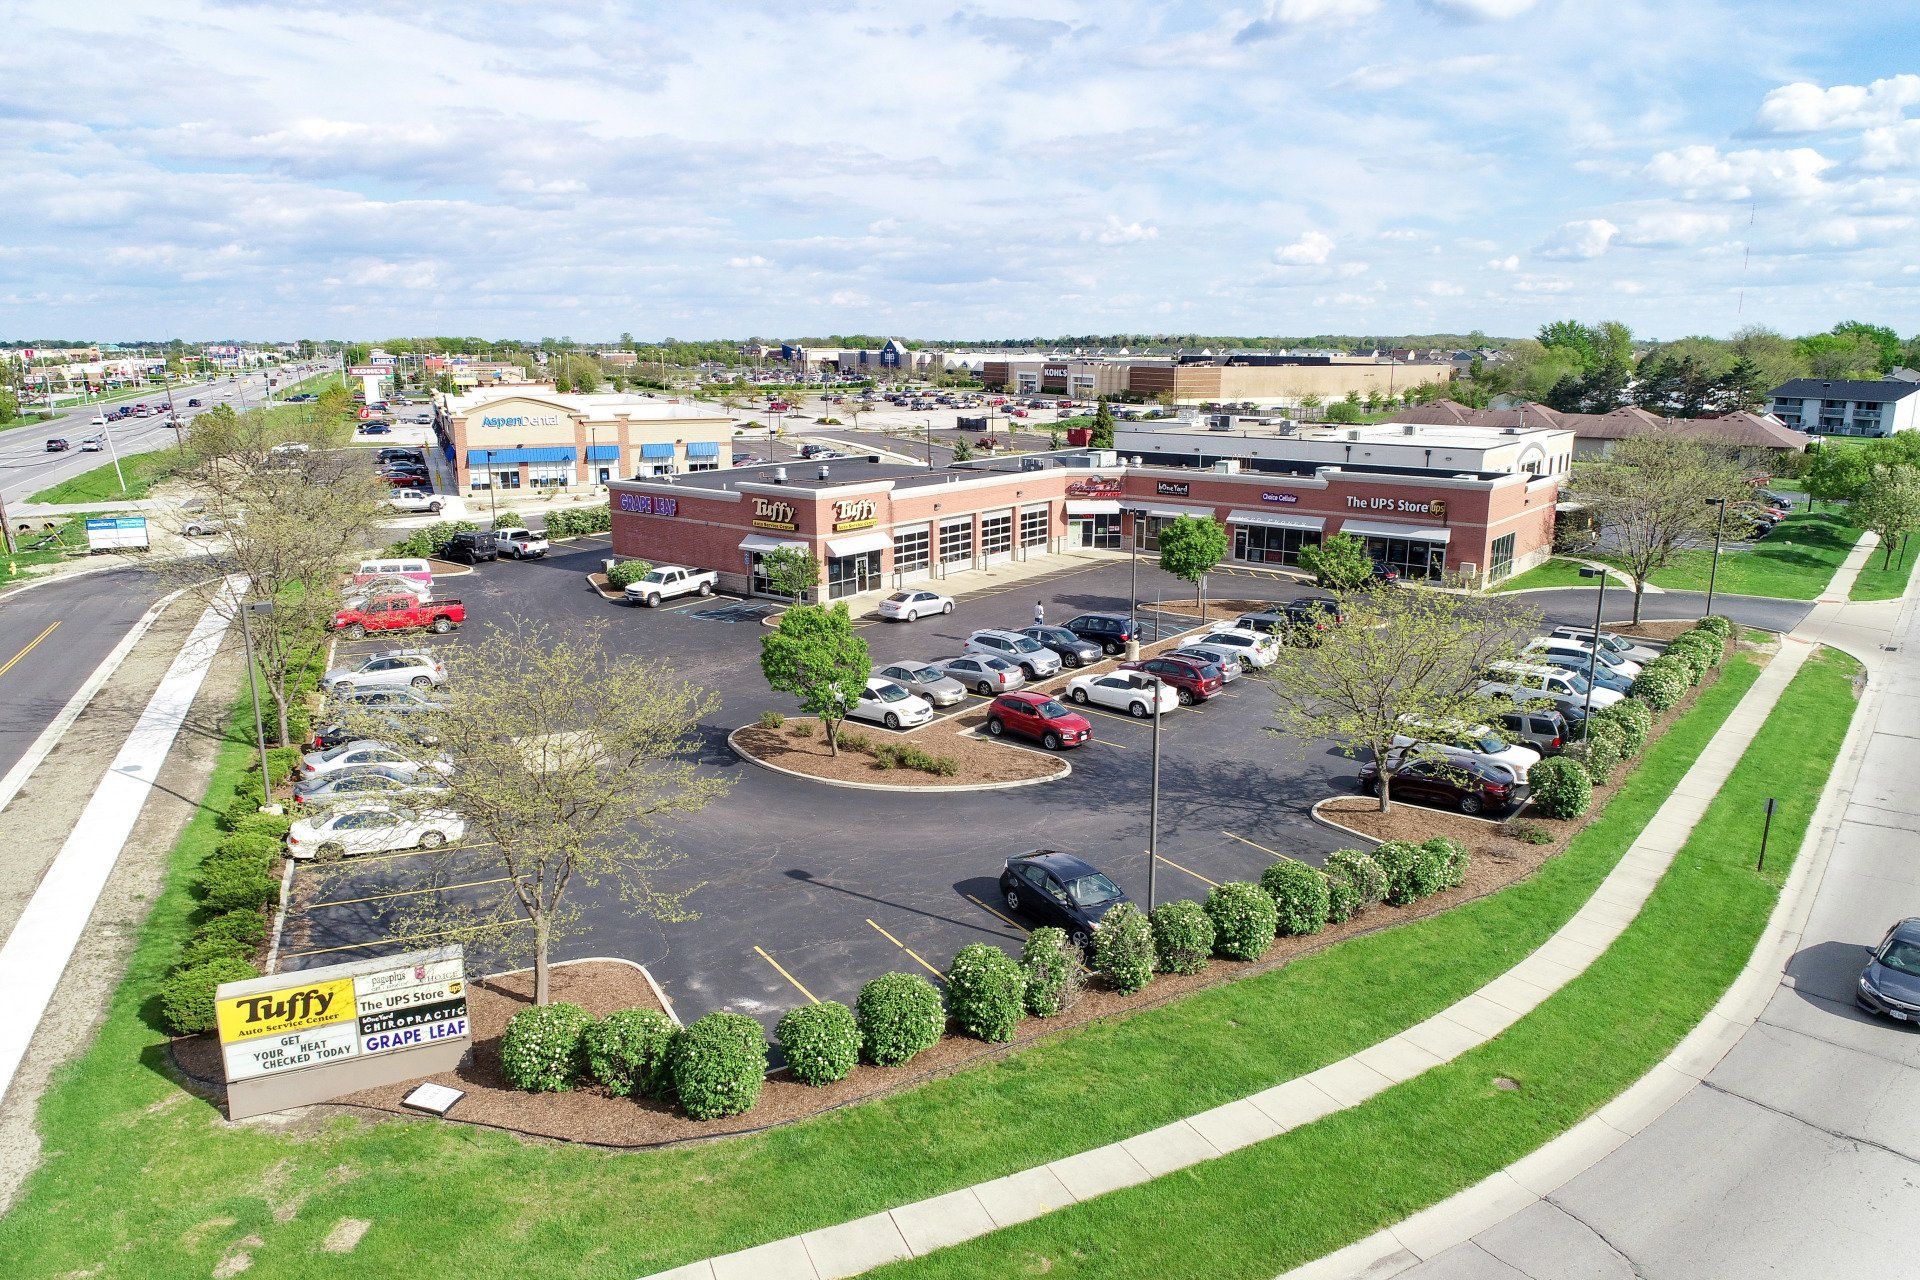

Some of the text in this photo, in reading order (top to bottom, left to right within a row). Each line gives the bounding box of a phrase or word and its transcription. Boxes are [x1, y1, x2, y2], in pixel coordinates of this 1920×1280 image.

[1044, 368, 1068, 377] KOHL'S
[620, 493, 676, 517] GRAPE LEAF
[752, 498, 795, 522] Tuffy
[835, 499, 878, 520] Tuffy
[1279, 495, 1297, 503] Cellular
[1346, 495, 1367, 508] The
[1370, 497, 1395, 511] UPS
[1397, 500, 1429, 513] Store
[236, 989, 334, 1024] Tuffy
[360, 984, 462, 1012] The UPS Store ups
[238, 1013, 340, 1038] Auto Service Center
[363, 1006, 465, 1033] CHIROPRACTIC
[281, 1035, 301, 1046] GET
[366, 1020, 466, 1051] GRAPE LEAF
[253, 1040, 327, 1062] YOUR HEAT
[262, 1045, 351, 1070] CHECKED TODAY
